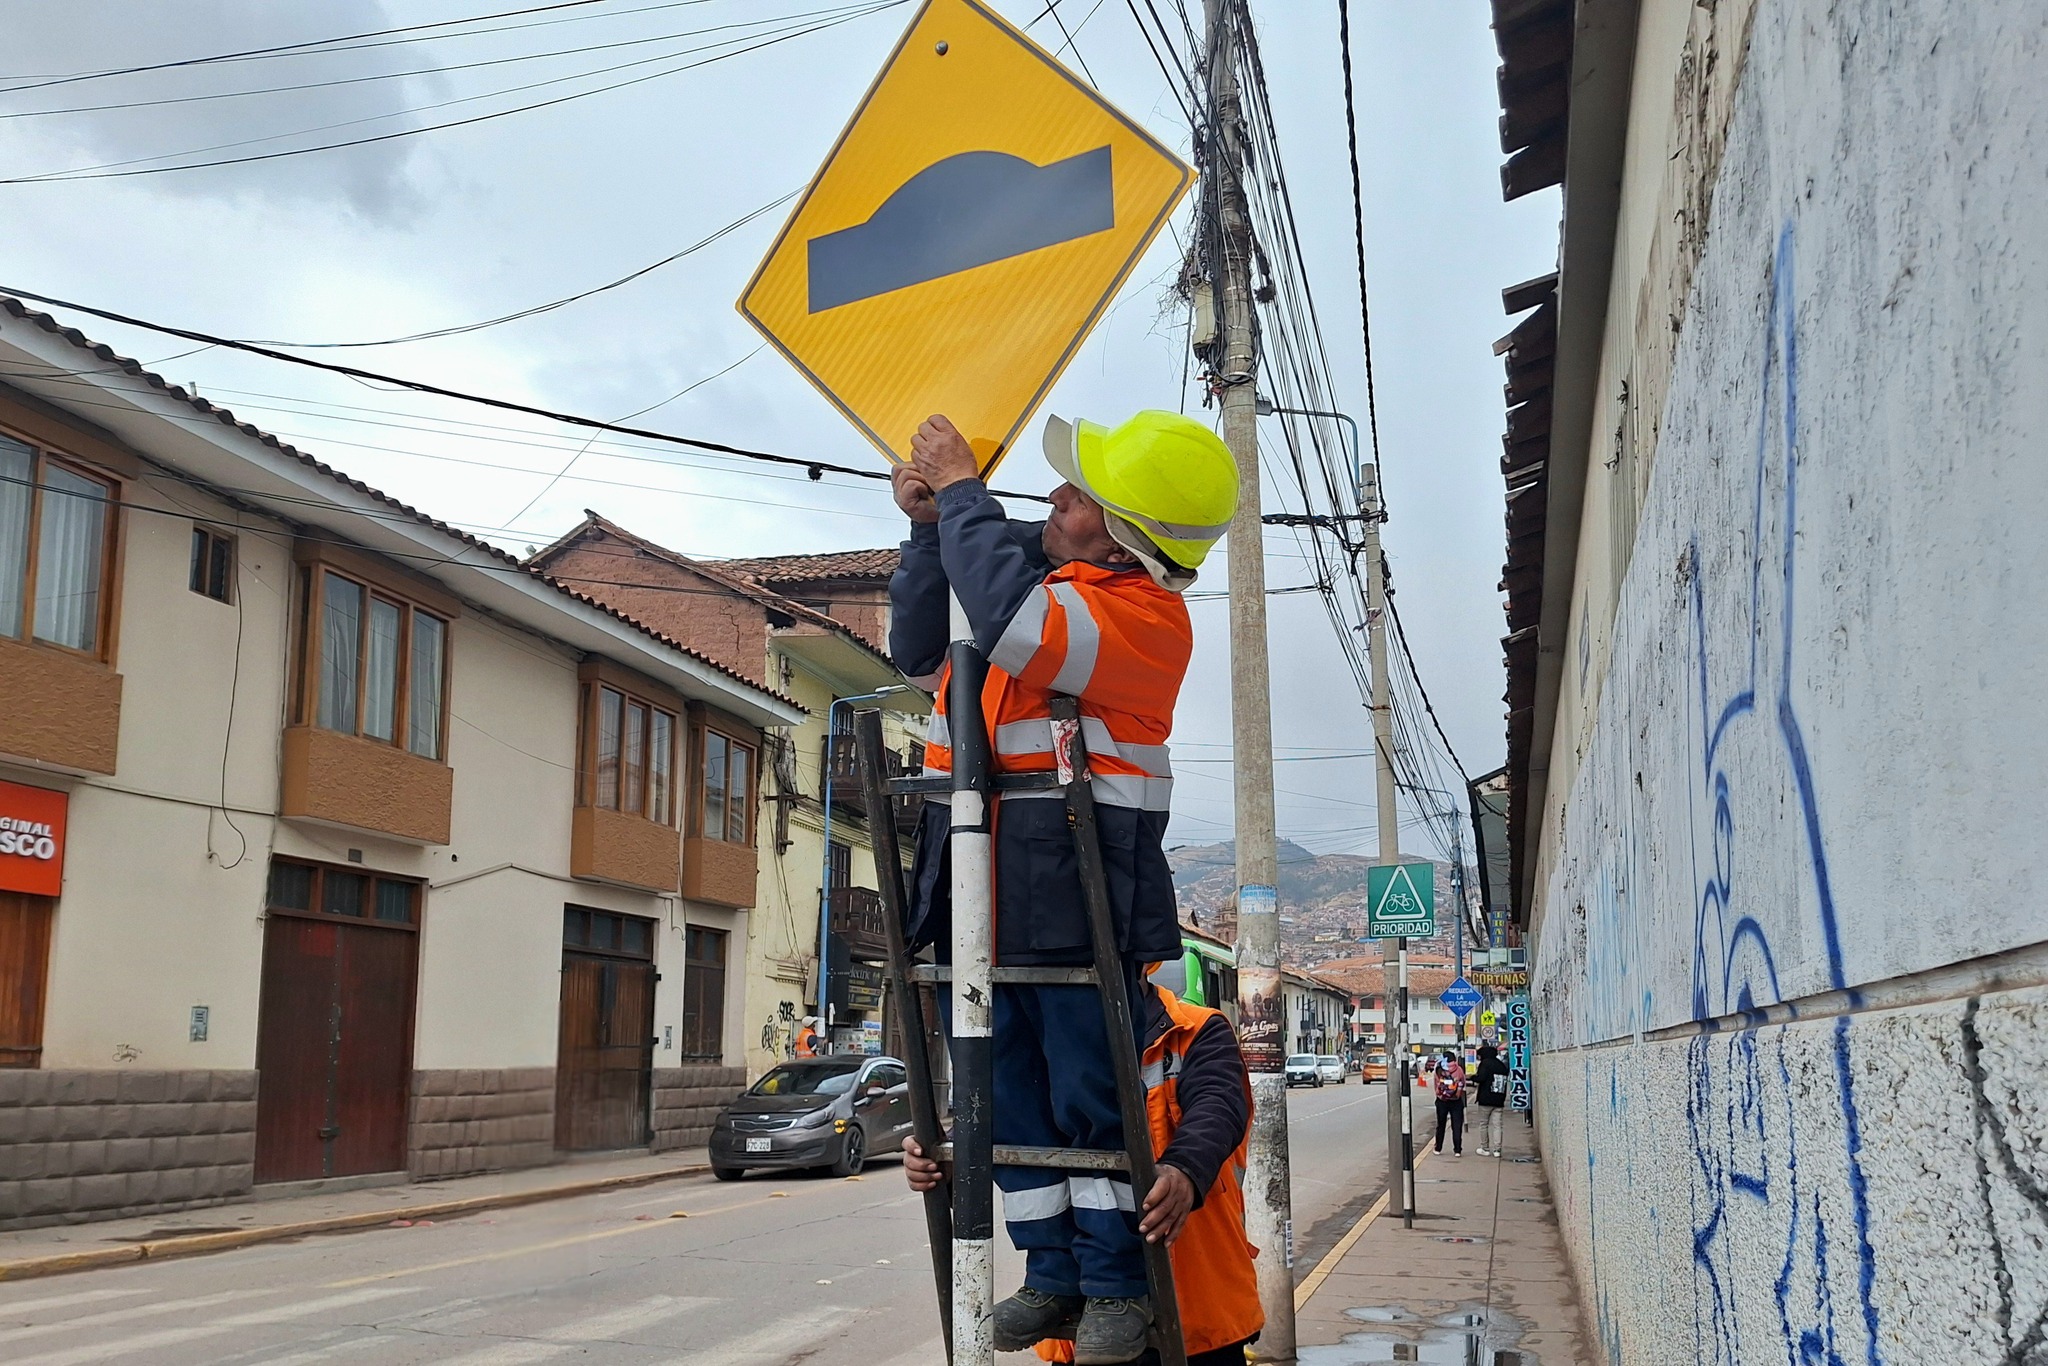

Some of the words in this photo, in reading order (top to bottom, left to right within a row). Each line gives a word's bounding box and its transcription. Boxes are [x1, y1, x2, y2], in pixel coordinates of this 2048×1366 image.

[1373, 922, 1430, 935] PRIORIDAD
[1472, 972, 1526, 985] CORTINAS
[1510, 1003, 1528, 1107] CORTINAS
